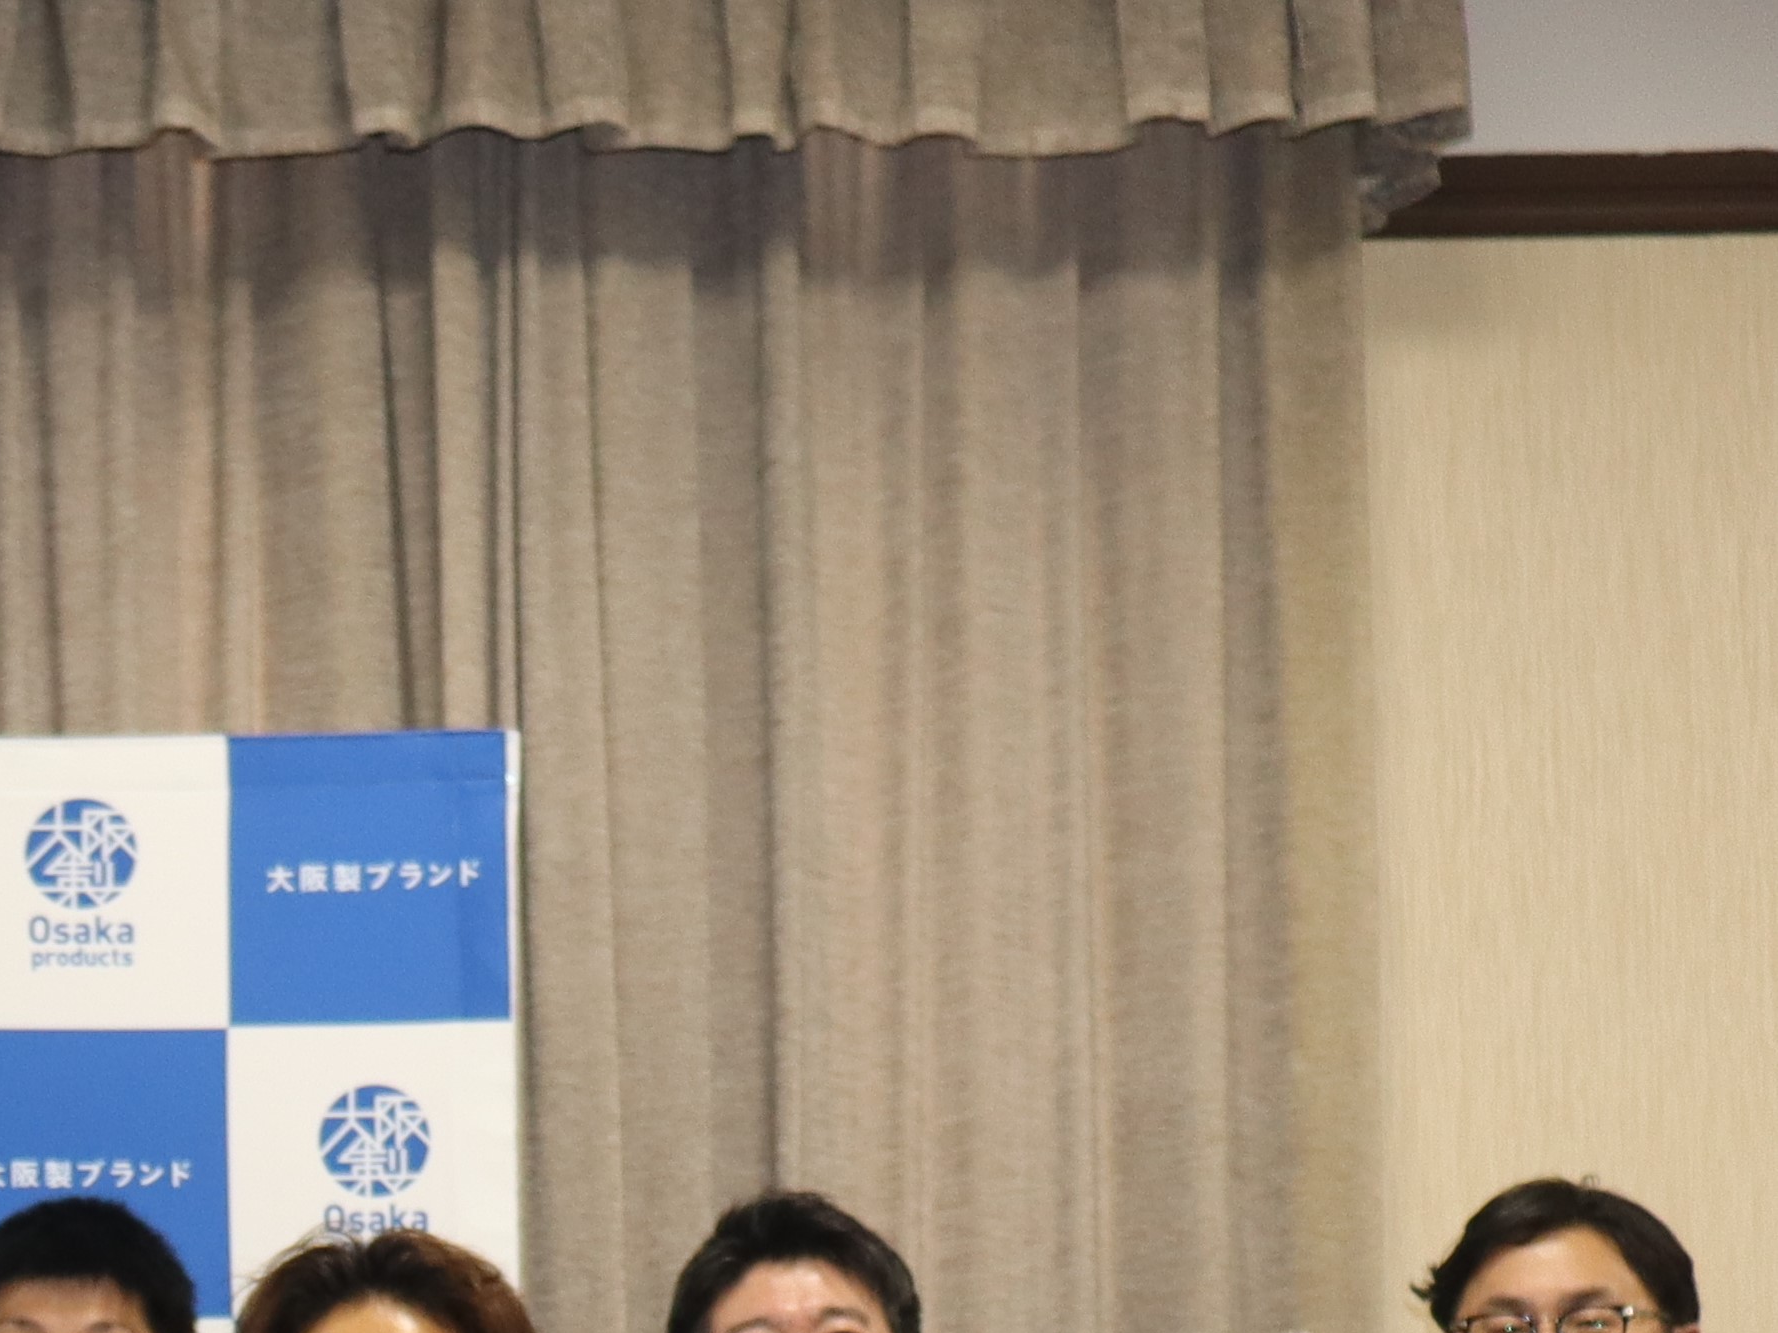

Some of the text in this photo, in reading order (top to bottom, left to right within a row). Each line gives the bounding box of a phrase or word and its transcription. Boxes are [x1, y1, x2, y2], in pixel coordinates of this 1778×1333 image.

[266, 859, 480, 894] 大阪製ブランド
[29, 916, 134, 944] Osaka
[31, 947, 133, 967] products
[324, 1204, 429, 1234] Osaka
